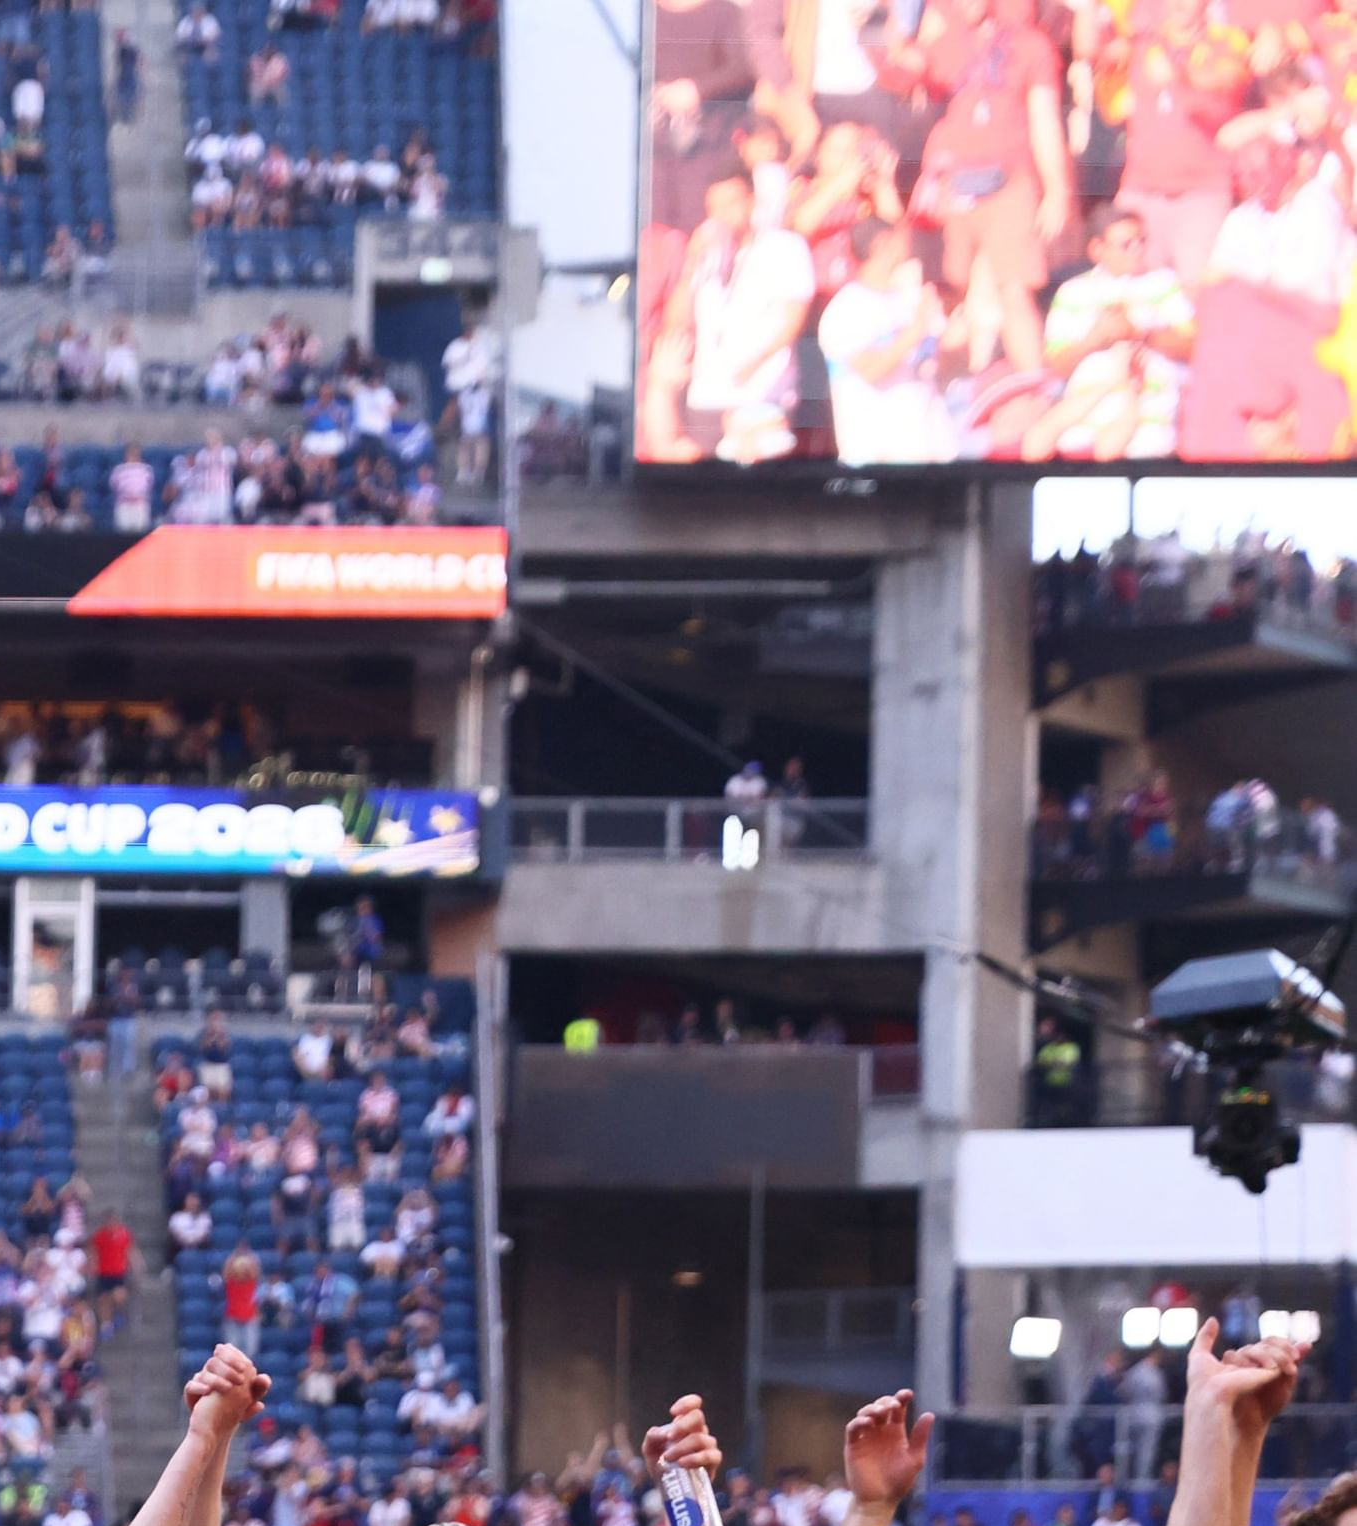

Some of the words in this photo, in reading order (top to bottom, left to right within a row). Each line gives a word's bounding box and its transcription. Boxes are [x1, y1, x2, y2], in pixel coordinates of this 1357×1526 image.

[257, 551, 335, 592] FIFA
[336, 551, 465, 593] WORLD
[30, 801, 148, 855] CUP
[146, 803, 344, 856] 2026
